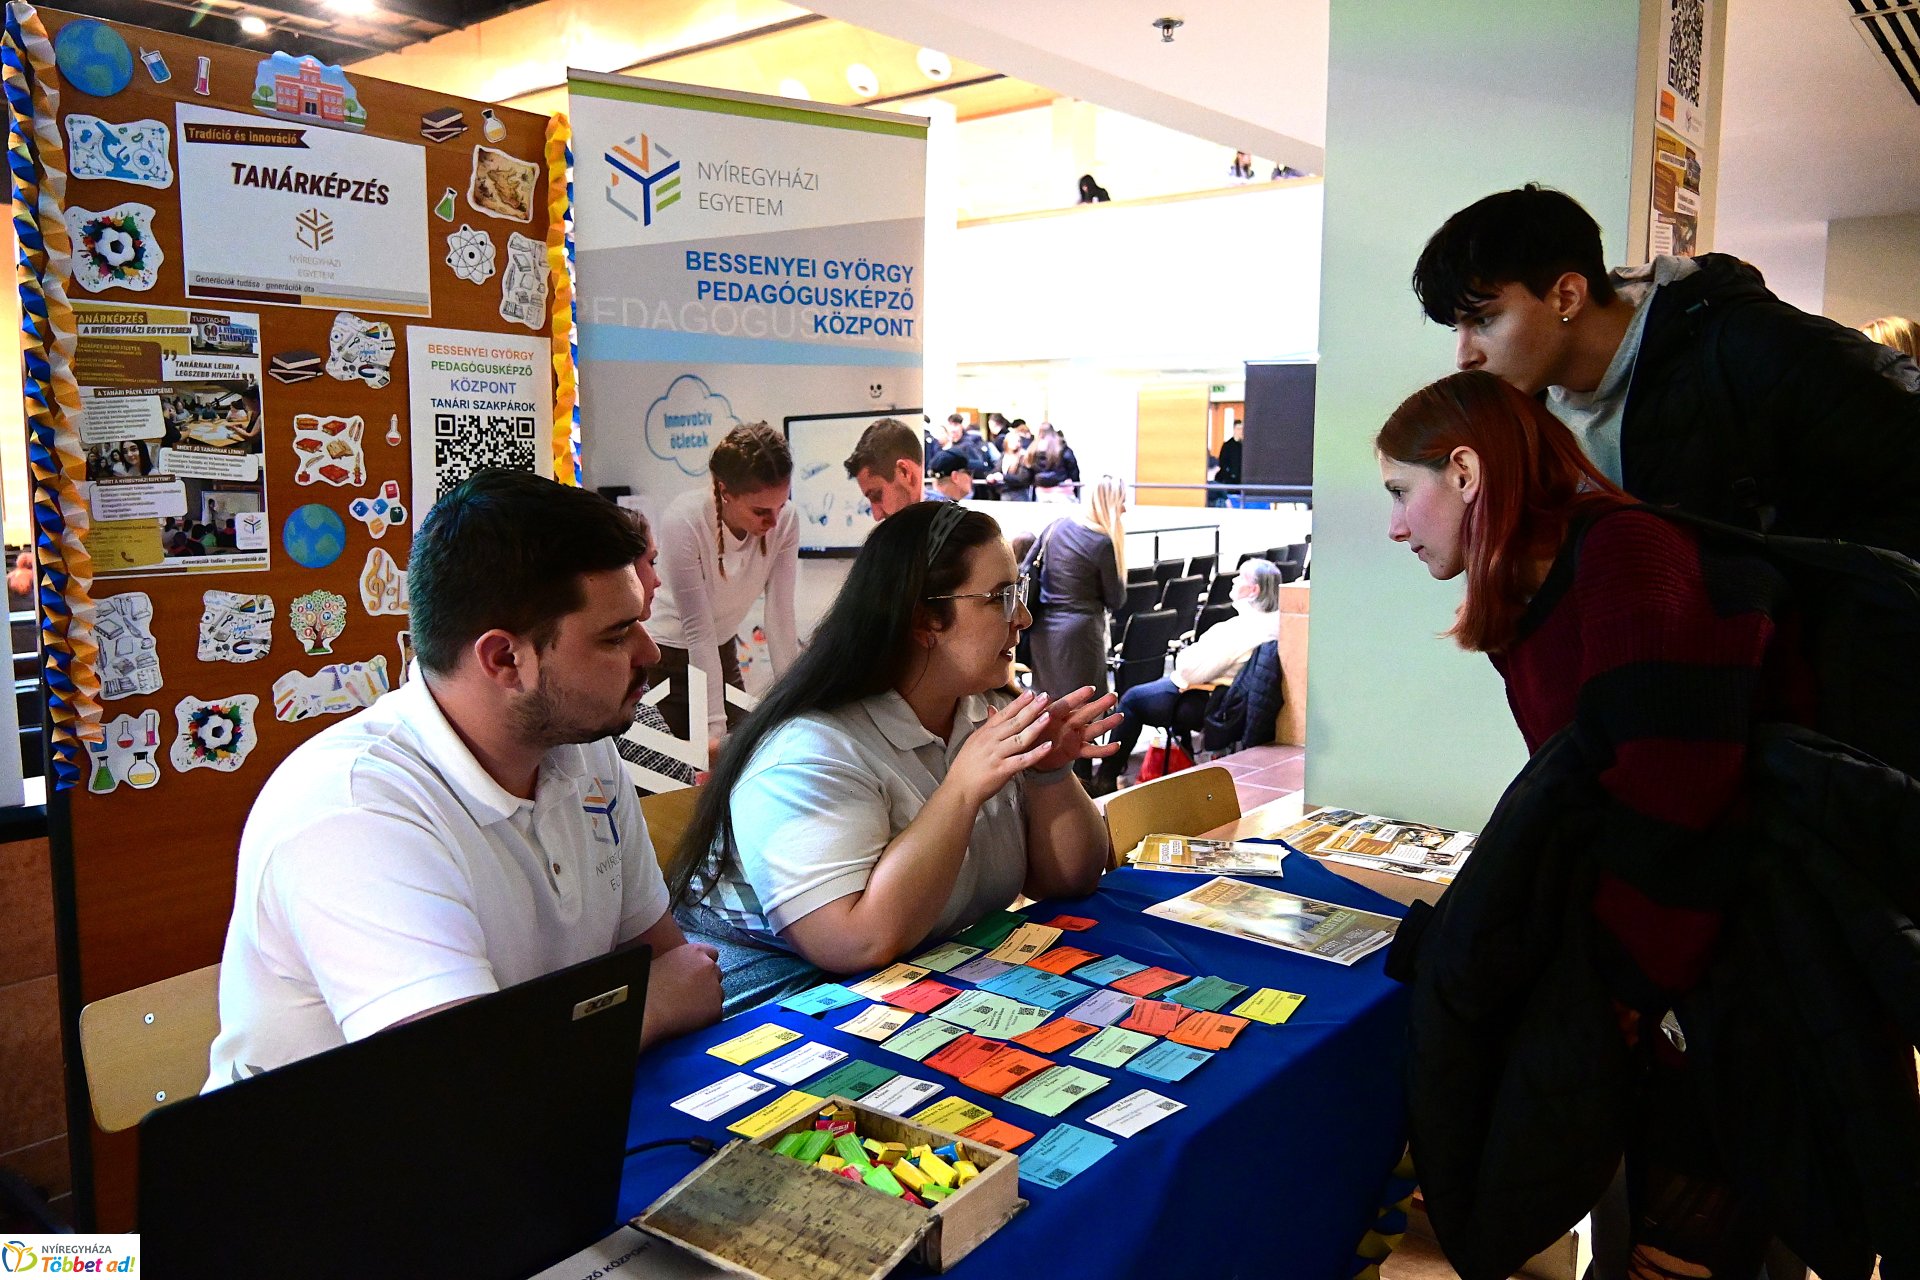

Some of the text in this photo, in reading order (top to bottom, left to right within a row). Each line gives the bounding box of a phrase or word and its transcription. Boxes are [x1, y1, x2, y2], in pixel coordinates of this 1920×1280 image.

[234, 129, 246, 142] és
[231, 161, 390, 206] TANÁRKÉPZÉS
[697, 160, 819, 191] NYÍREGYHÁZI
[699, 191, 784, 216] EGYETEM
[289, 253, 342, 268] NYÍREGYHÁZI
[686, 250, 914, 284] BESSENYEI GYÖRGY
[298, 269, 336, 281] EGYETEM
[195, 275, 315, 293] Generációk tudása generációk óta
[697, 280, 914, 311] PEDAGÓGUSKÉPZŐ
[83, 324, 193, 335] A NYÍREGYHÁZI EGYETEMEN
[204, 324, 218, 337] 60
[813, 311, 914, 337] KÖZPONT
[428, 344, 535, 361] BESSENYEI GYÖRGY
[175, 360, 213, 369] TANÁRNAK
[431, 360, 533, 377] PEDAGÓGUSKÉPZŐ
[175, 370, 240, 379] LEGSZEBB HIVATÁS
[450, 377, 517, 394] KÖZPONT
[430, 397, 536, 412] TANÁRI SZAKPÁROK
[670, 431, 709, 449] ötletek
[580, 1240, 652, 1280] ZŐ KÖZPONT
